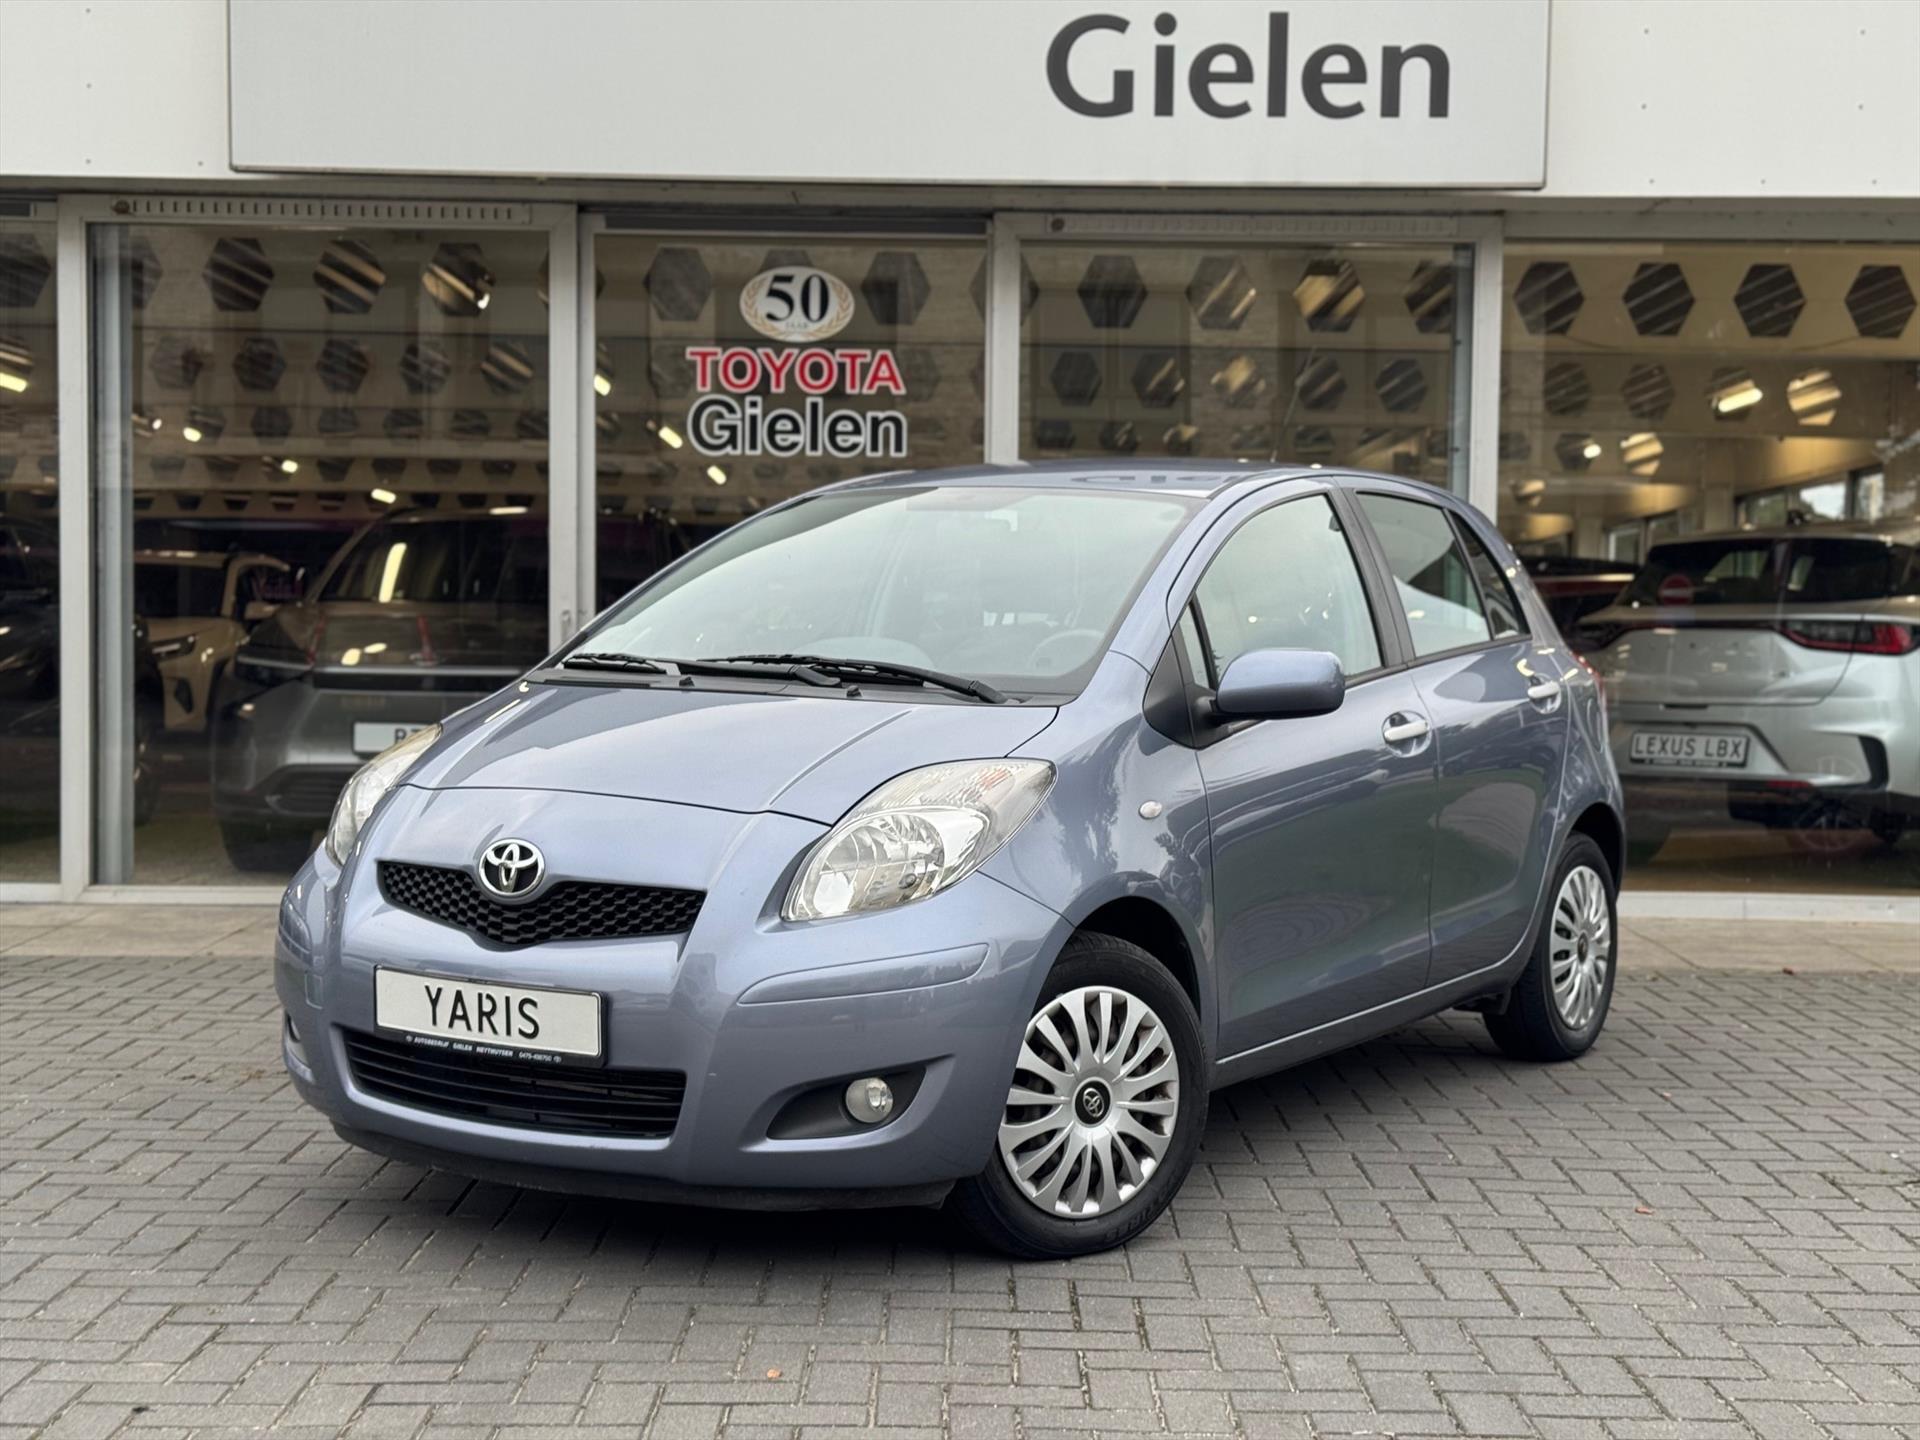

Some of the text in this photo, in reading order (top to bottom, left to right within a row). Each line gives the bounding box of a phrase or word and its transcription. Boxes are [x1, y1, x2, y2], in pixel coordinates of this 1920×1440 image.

[1046, 11, 1450, 119] Gielen
[765, 273, 830, 323] 50
[686, 346, 906, 395] TOYOTA
[687, 394, 909, 458] Gielen
[1634, 735, 1743, 759] LEXUS LBX
[424, 984, 541, 1040] YARIS
